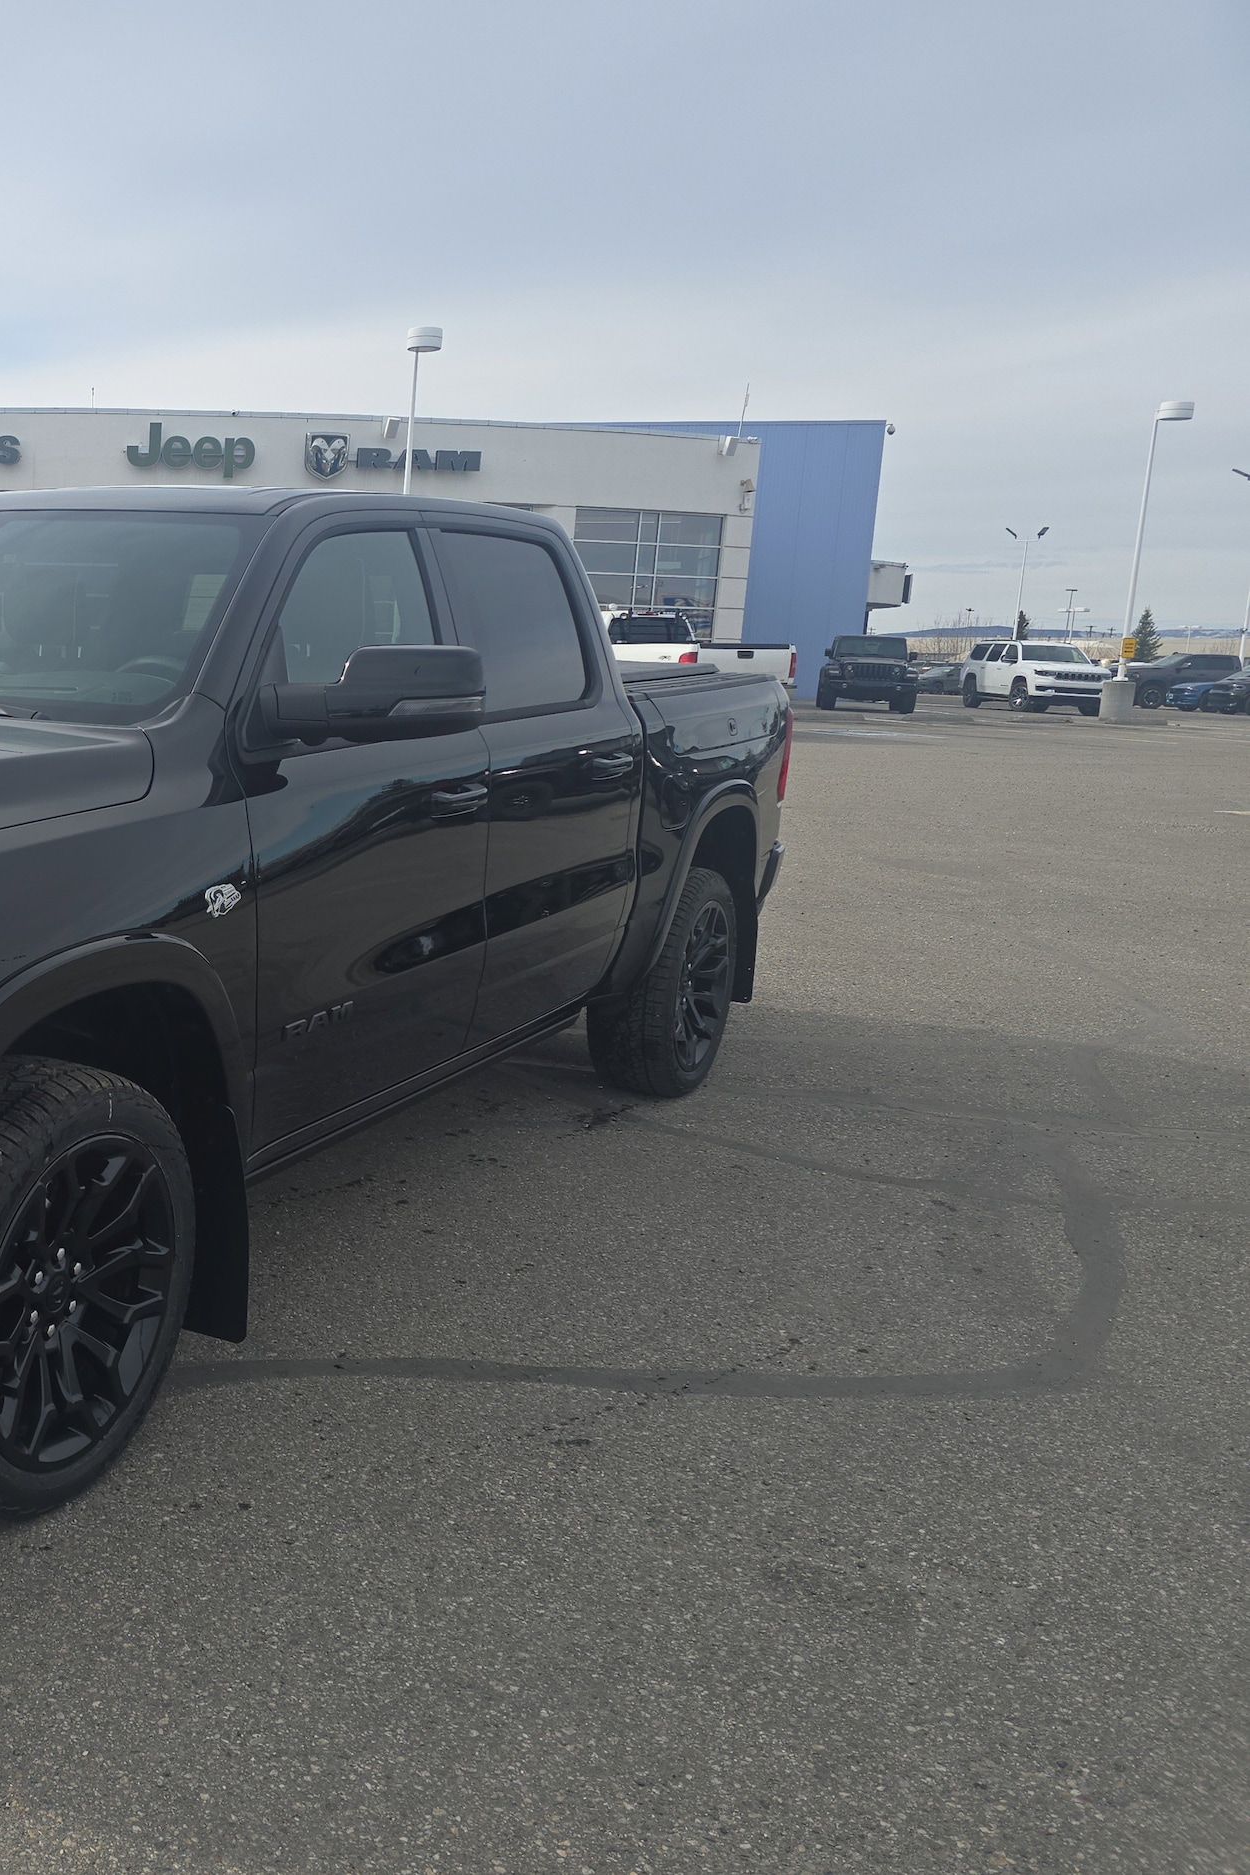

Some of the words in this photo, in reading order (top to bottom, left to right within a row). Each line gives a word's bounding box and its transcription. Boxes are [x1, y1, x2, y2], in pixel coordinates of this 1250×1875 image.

[126, 422, 256, 480] Jeep
[356, 447, 482, 471] RAM
[281, 1000, 354, 1042] RAM
